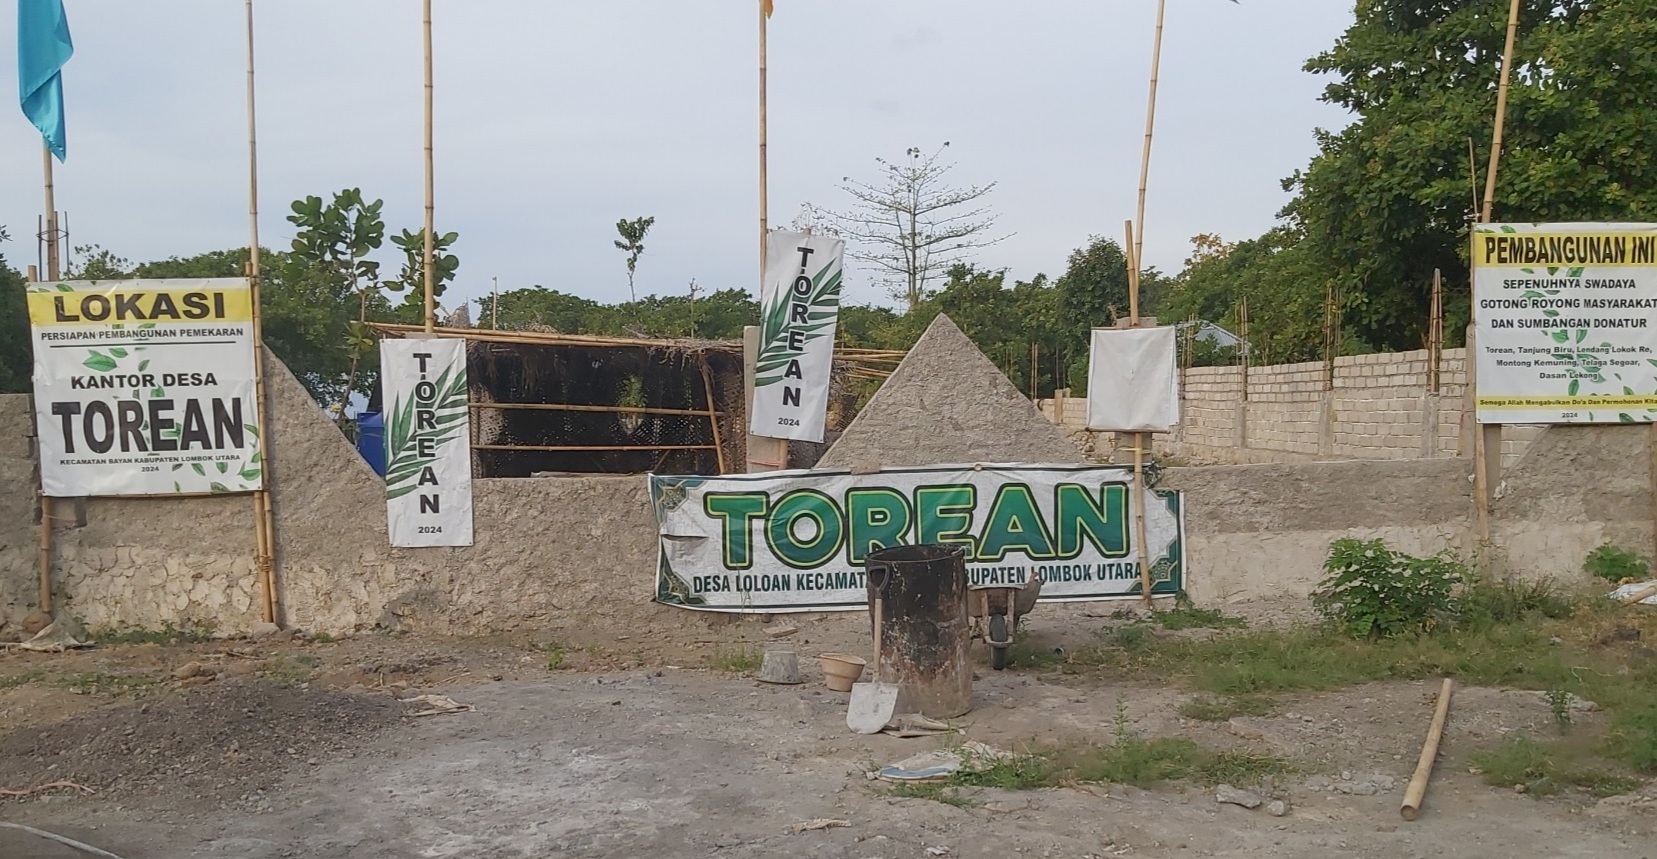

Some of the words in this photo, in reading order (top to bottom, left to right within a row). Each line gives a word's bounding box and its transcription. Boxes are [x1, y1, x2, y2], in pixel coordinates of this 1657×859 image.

[1485, 236, 1626, 264] PEMBANGUNAN
[1631, 236, 1656, 264] INI
[1503, 279, 1581, 289] SEPENUHNYA
[1584, 279, 1636, 289] SWADAYA
[54, 292, 226, 323] LOKASI
[1480, 299, 1528, 309] GOTONG
[1531, 299, 1580, 309] ROYONG
[1584, 298, 1657, 309] MASYARAKAT
[782, 247, 815, 407] TOREAN
[1491, 319, 1514, 329] DAN
[1517, 318, 1591, 329] SUMBANGAN
[1593, 318, 1647, 328] DONATUR
[41, 332, 96, 341] PERSIAPAN
[99, 329, 177, 339] PEMBANGUNAN
[180, 328, 244, 337] PEMEKARAN
[1485, 346, 1515, 355] Torean,
[1518, 346, 1551, 355] Tanjung
[1554, 346, 1575, 354] Biru,
[1496, 359, 1532, 367] Montong
[1534, 359, 1579, 367] Kemuning,
[1582, 359, 1607, 367] Telaga
[1609, 359, 1640, 367] Segoar,
[71, 374, 156, 390] KANTOR
[163, 372, 218, 387] DESA
[51, 397, 245, 454] TOREAN
[777, 417, 800, 427] 2024
[413, 353, 440, 514] TOREAN
[134, 456, 179, 464] KABUPATEN
[418, 526, 443, 534] 2024
[702, 481, 1131, 570] TOREAN
[693, 575, 731, 593] DESA
[736, 574, 791, 592] LOLOAN
[796, 571, 867, 590] KECAMAT
[1096, 562, 1142, 581] UTARA
